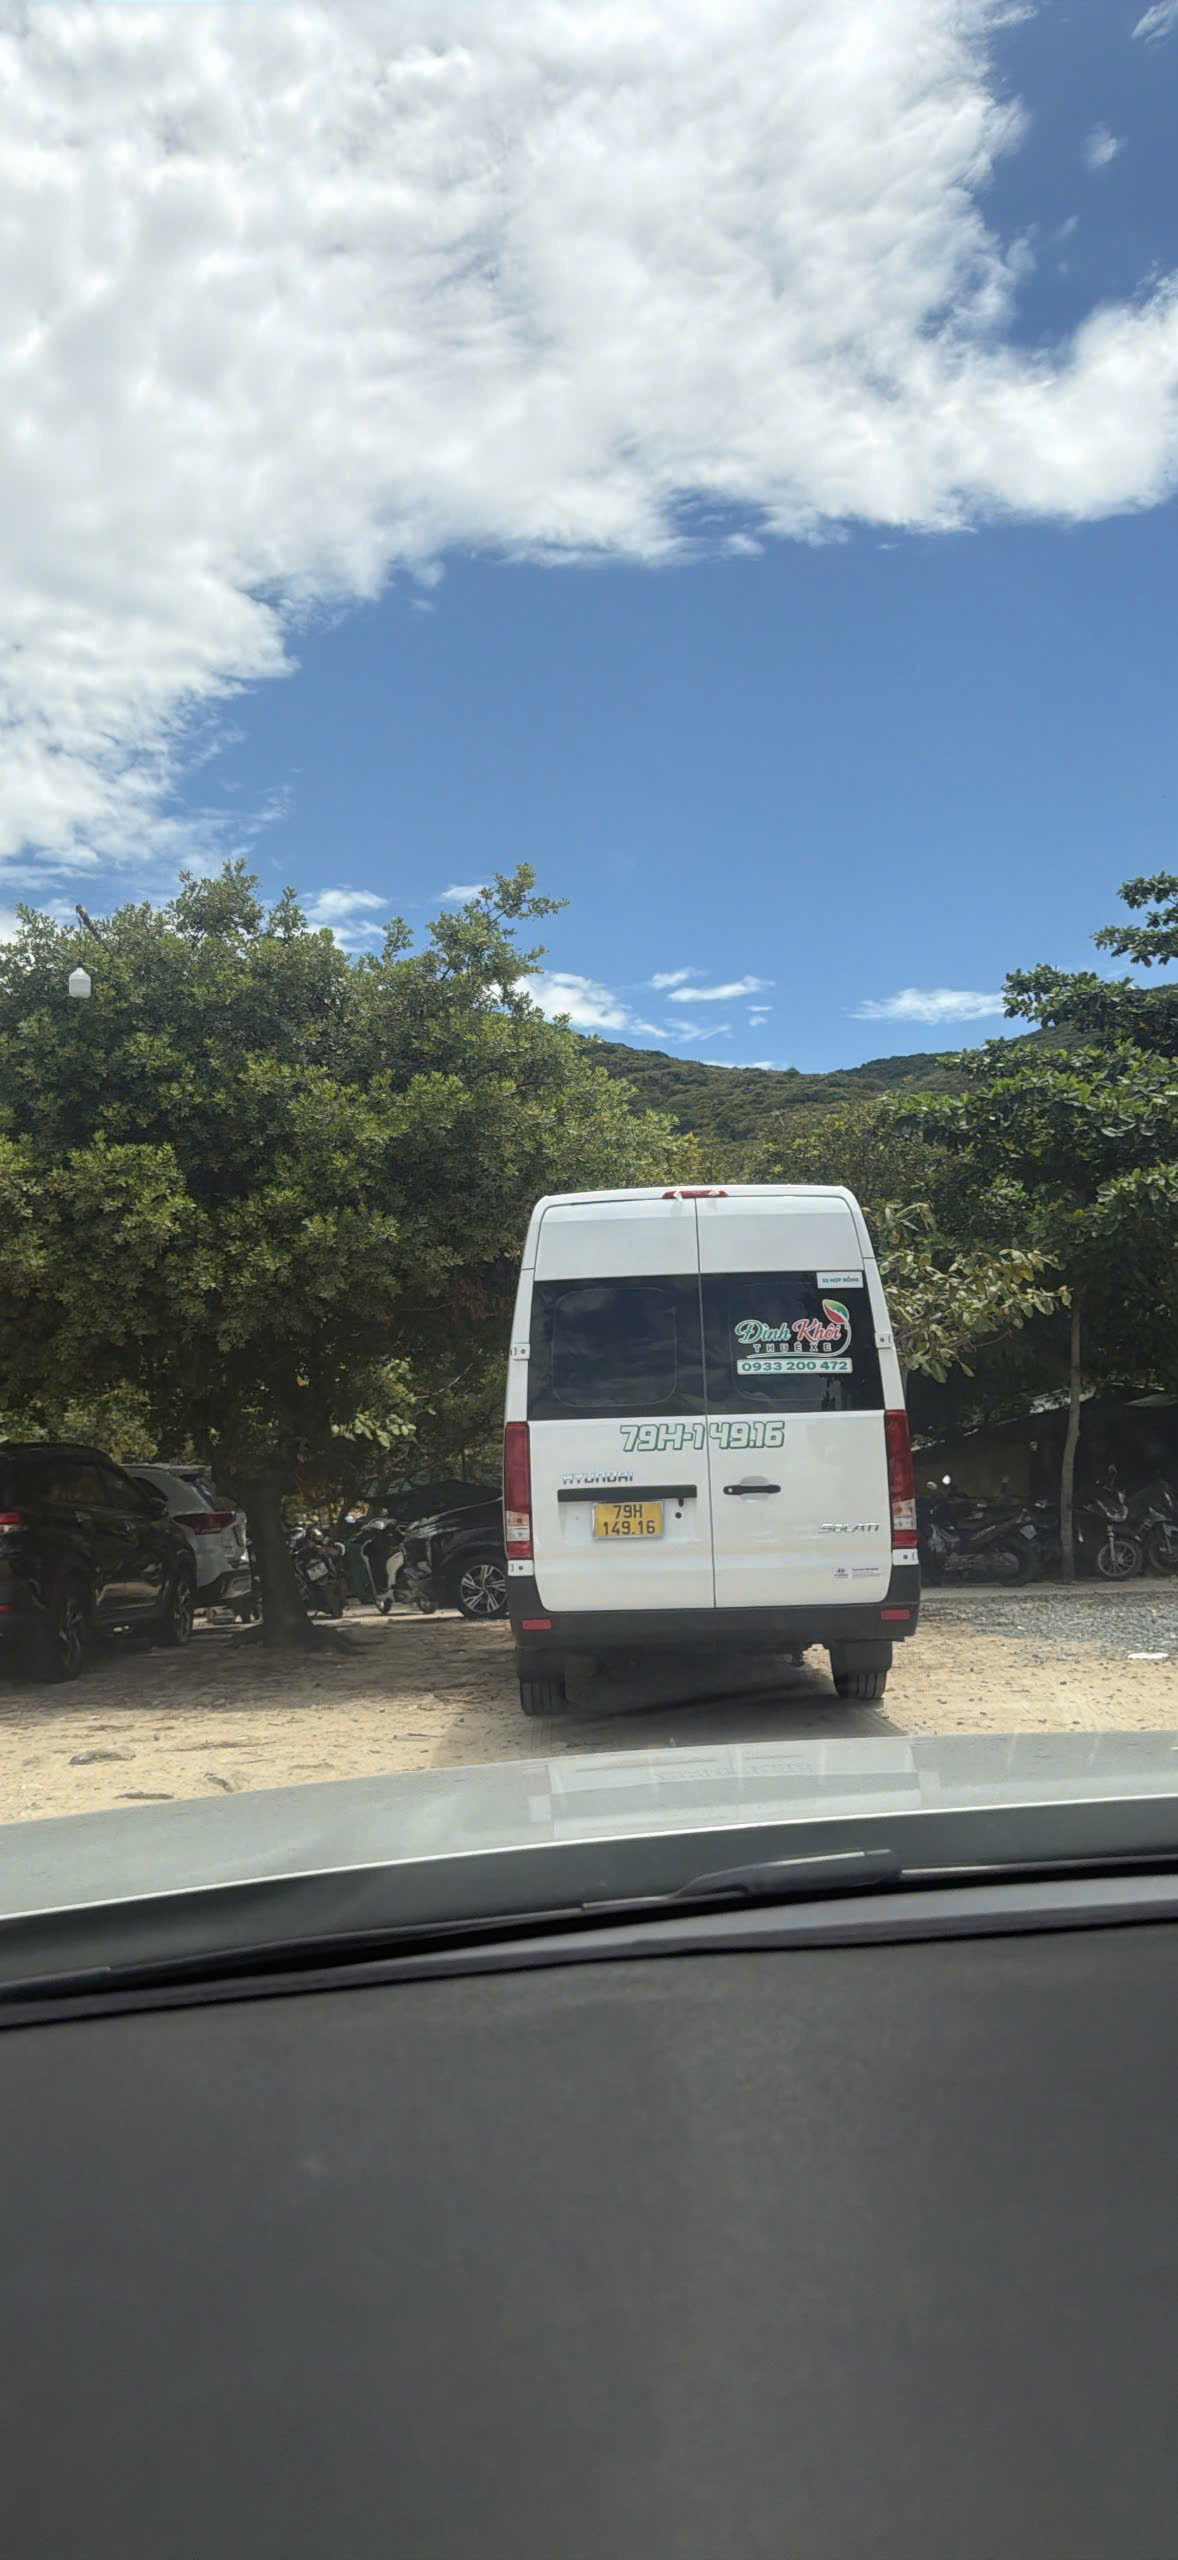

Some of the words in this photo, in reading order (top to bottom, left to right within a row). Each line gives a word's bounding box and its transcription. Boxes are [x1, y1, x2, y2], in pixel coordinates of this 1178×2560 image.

[735, 1319, 791, 1344] Đình
[792, 1318, 841, 1344] Khôi
[753, 1341, 802, 1353] THUÊ
[810, 1342, 832, 1352] XE
[741, 1362, 782, 1372] 0933
[786, 1361, 816, 1371] 200
[820, 1361, 848, 1370] 472
[613, 1504, 643, 1519] 79H
[602, 1520, 656, 1536] 149.16
